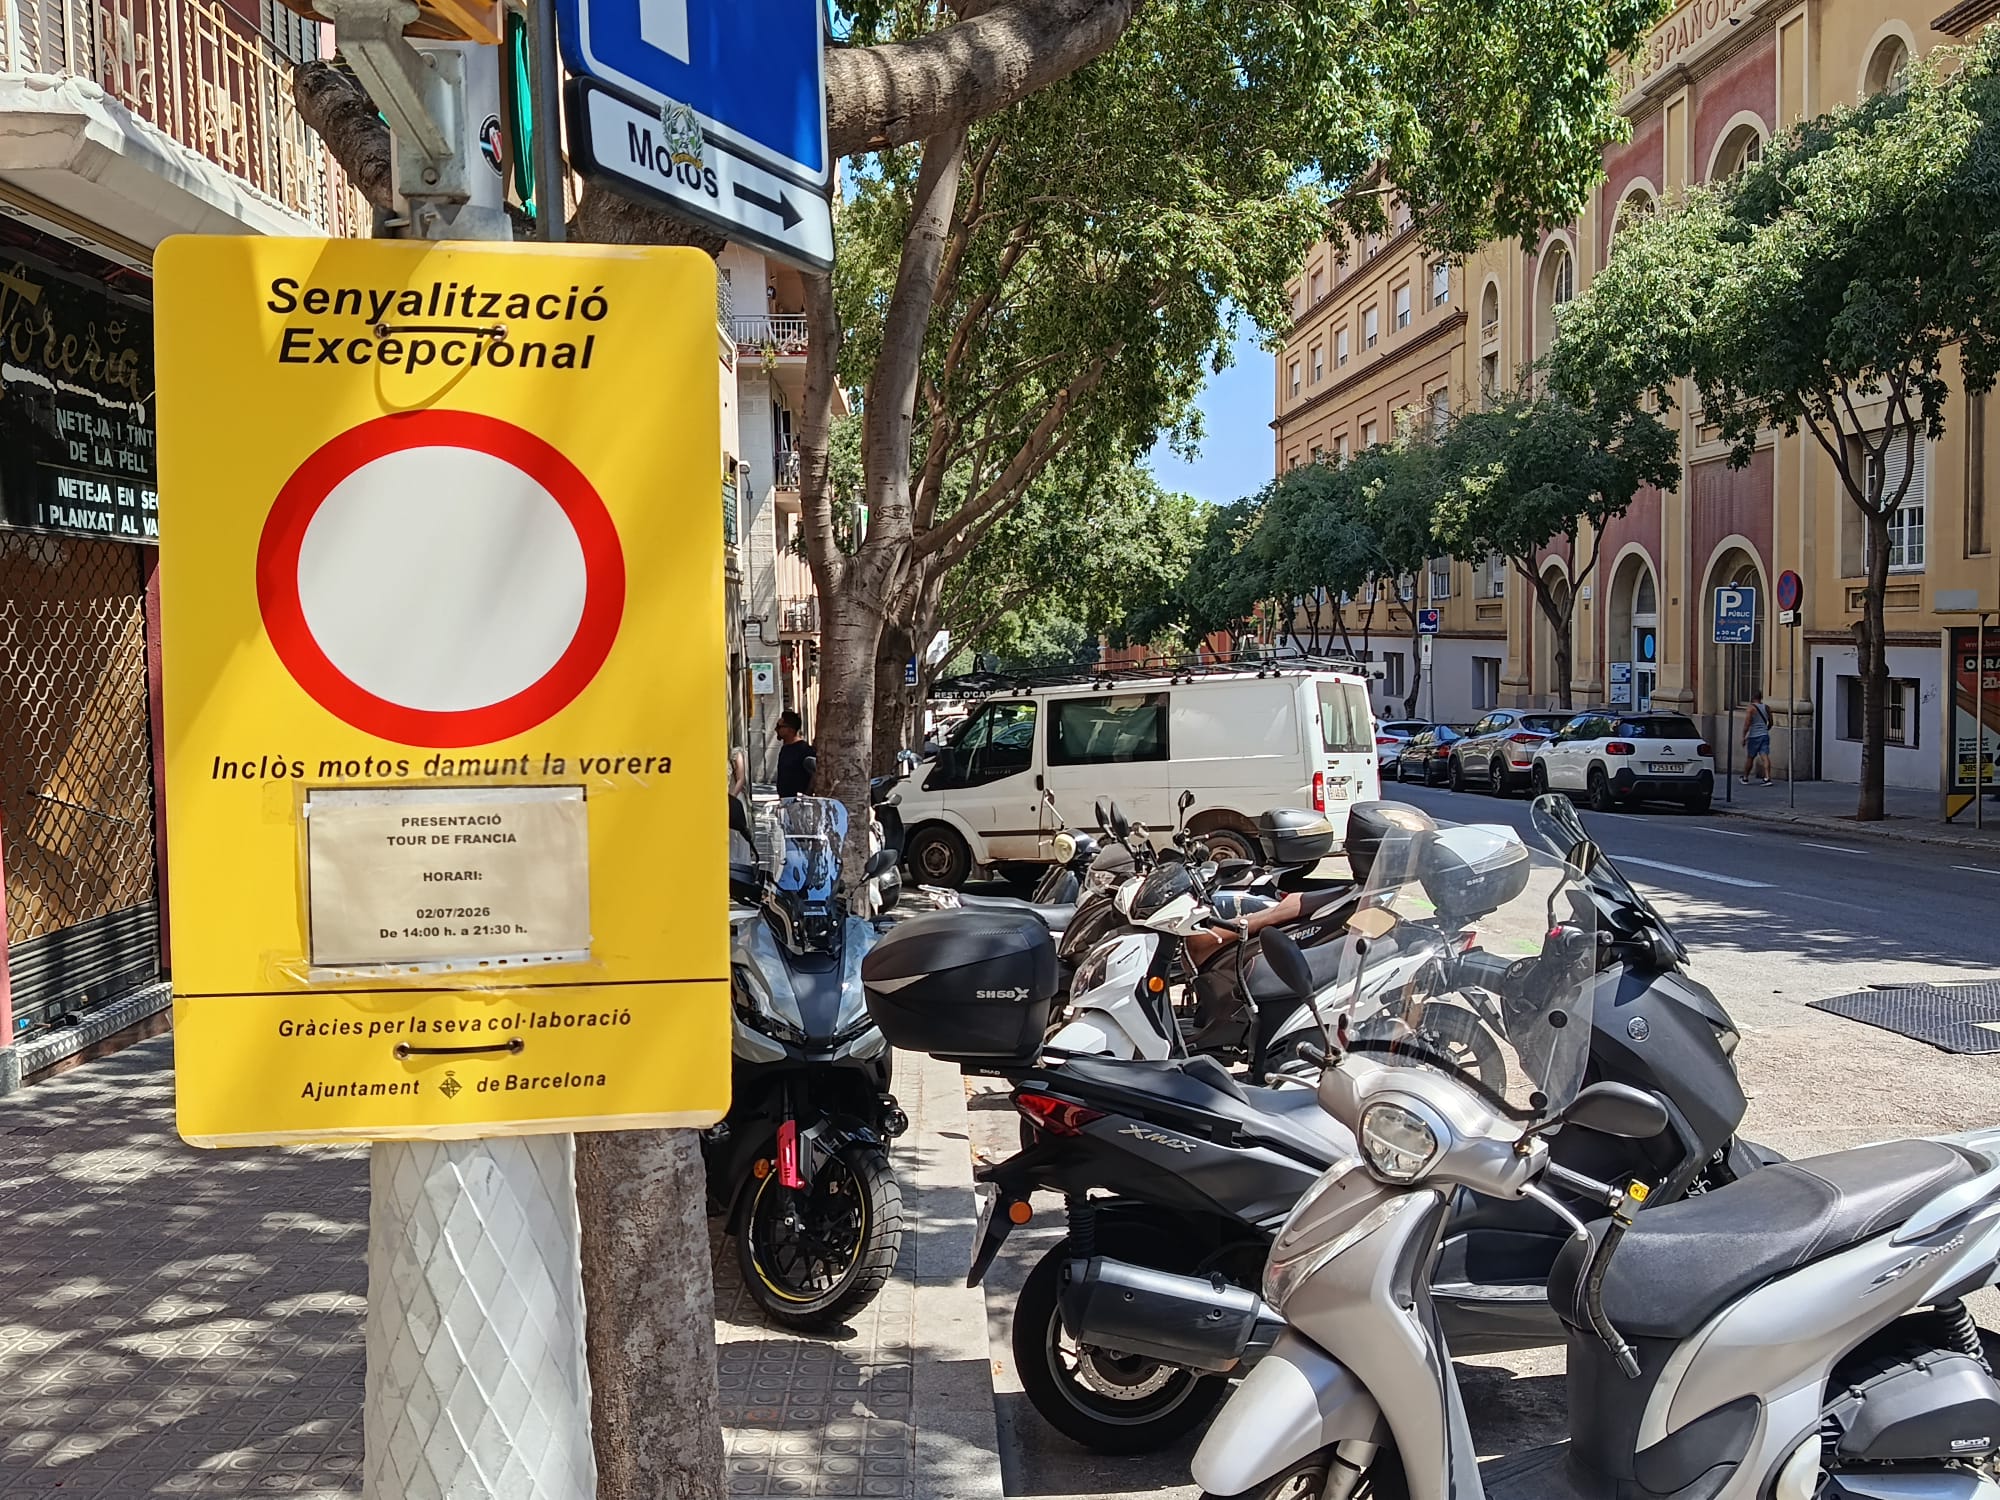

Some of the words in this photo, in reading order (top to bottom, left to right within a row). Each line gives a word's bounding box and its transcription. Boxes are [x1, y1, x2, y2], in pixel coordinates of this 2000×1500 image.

[627, 121, 719, 198] Motos
[267, 277, 609, 325] Senyalització
[279, 326, 595, 375] Excepcional
[56, 407, 111, 438] NETEJA
[116, 421, 121, 441] I
[126, 424, 154, 448] TINT
[69, 440, 88, 463] DE
[95, 446, 114, 468] LA
[119, 450, 148, 474] PELL
[57, 476, 112, 504] NETEJA
[117, 486, 135, 508] EN
[38, 503, 43, 523] I
[50, 505, 114, 532] PLANXAT
[120, 514, 139, 535] AL
[934, 691, 960, 699] REST.
[212, 755, 305, 780] Inclòs
[318, 755, 410, 778] motos
[423, 753, 530, 777] damunt
[542, 752, 566, 776] la
[579, 755, 672, 775] vorera
[401, 813, 502, 828] PRESENTACIÓ
[387, 835, 427, 846] TOUR
[431, 835, 450, 845] DE
[454, 832, 517, 845] FRANCIA
[423, 870, 482, 882] HORARI:
[416, 906, 491, 919] 02/07/2026
[379, 928, 398, 939] De
[402, 926, 440, 938] 14:00
[443, 926, 457, 937] h.
[460, 928, 470, 936] a
[473, 924, 511, 936] 21:30
[515, 924, 528, 934] h.
[278, 1017, 363, 1037] Gràcies
[368, 1018, 405, 1039] per
[409, 1016, 427, 1033] la
[431, 1019, 482, 1033] seva
[488, 1008, 632, 1030] col·laboració
[300, 1080, 420, 1102] Ajuntament
[476, 1076, 500, 1093] de
[505, 1071, 606, 1091] Barcelona
